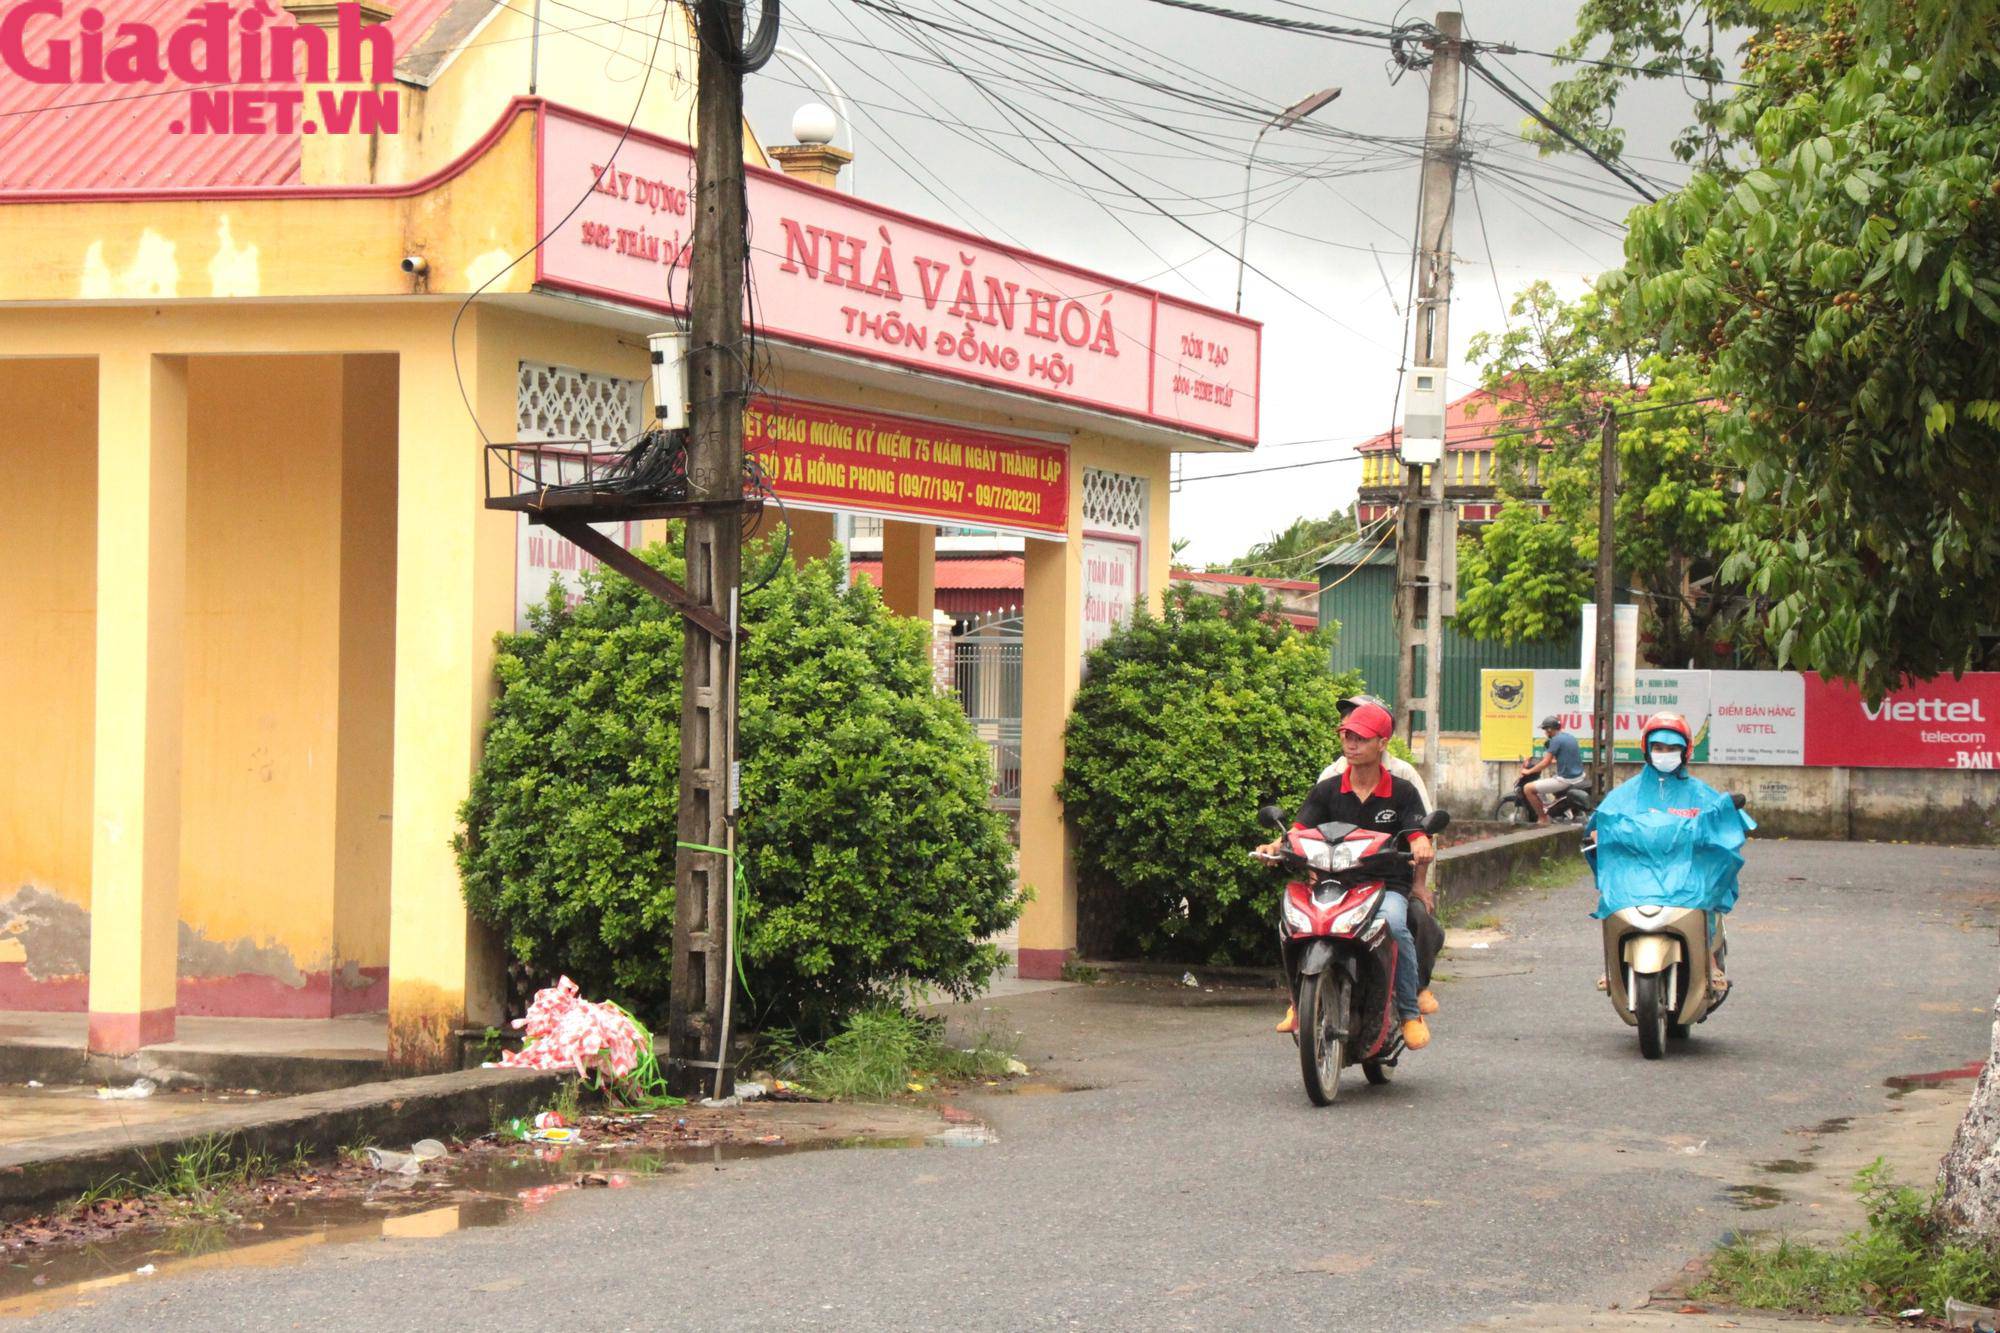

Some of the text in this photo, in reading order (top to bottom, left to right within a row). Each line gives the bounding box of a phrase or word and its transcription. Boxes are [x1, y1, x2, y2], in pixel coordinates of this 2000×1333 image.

[591, 161, 687, 216] XÂY DỰNG
[780, 217, 1119, 357] NHÀ VĂN HOÁ
[840, 306, 1074, 390] THÔN ĐỒNG HỘI
[1208, 342, 1229, 368] TẠO
[810, 419, 853, 450] MỪNG
[856, 423, 876, 454] KỶ
[877, 430, 912, 463] NIỆM
[915, 438, 930, 462] 75
[933, 438, 962, 467] NĂM
[965, 445, 997, 472] NGÀY
[1000, 450, 1038, 479] THÀNH
[1041, 456, 1062, 486] LẬP
[784, 453, 803, 483] XÃ
[807, 453, 846, 488] HỒNG
[849, 466, 895, 494] PHONG
[899, 473, 964, 503] (09/7/1947
[1736, 723, 1776, 734] VIETTEL
[1860, 698, 1986, 721] viettel
[1920, 730, 1986, 743] telecom
